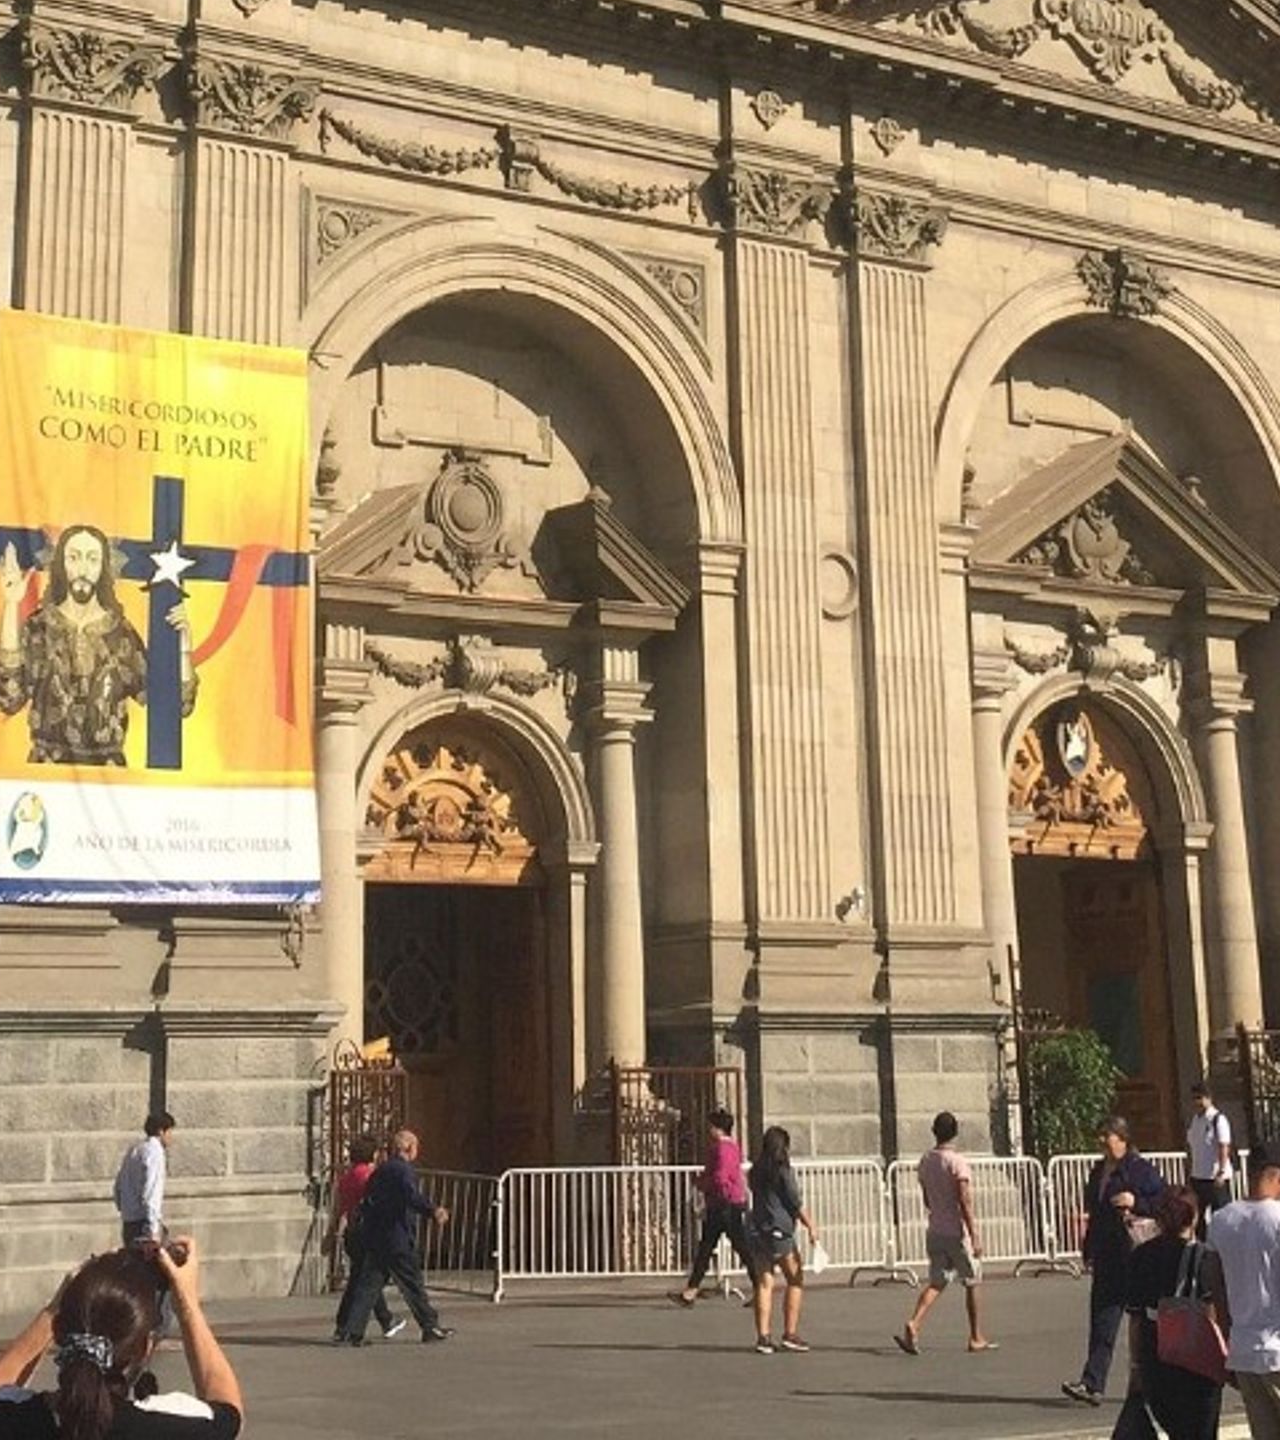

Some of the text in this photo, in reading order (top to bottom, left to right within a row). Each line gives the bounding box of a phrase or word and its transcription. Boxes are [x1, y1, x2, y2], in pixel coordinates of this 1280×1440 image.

[38, 415, 127, 449] COMO
[137, 428, 163, 453] EL
[164, 815, 201, 834] 2016
[71, 830, 114, 851] AÑO
[117, 834, 140, 853] DE
[144, 836, 164, 853] LA
